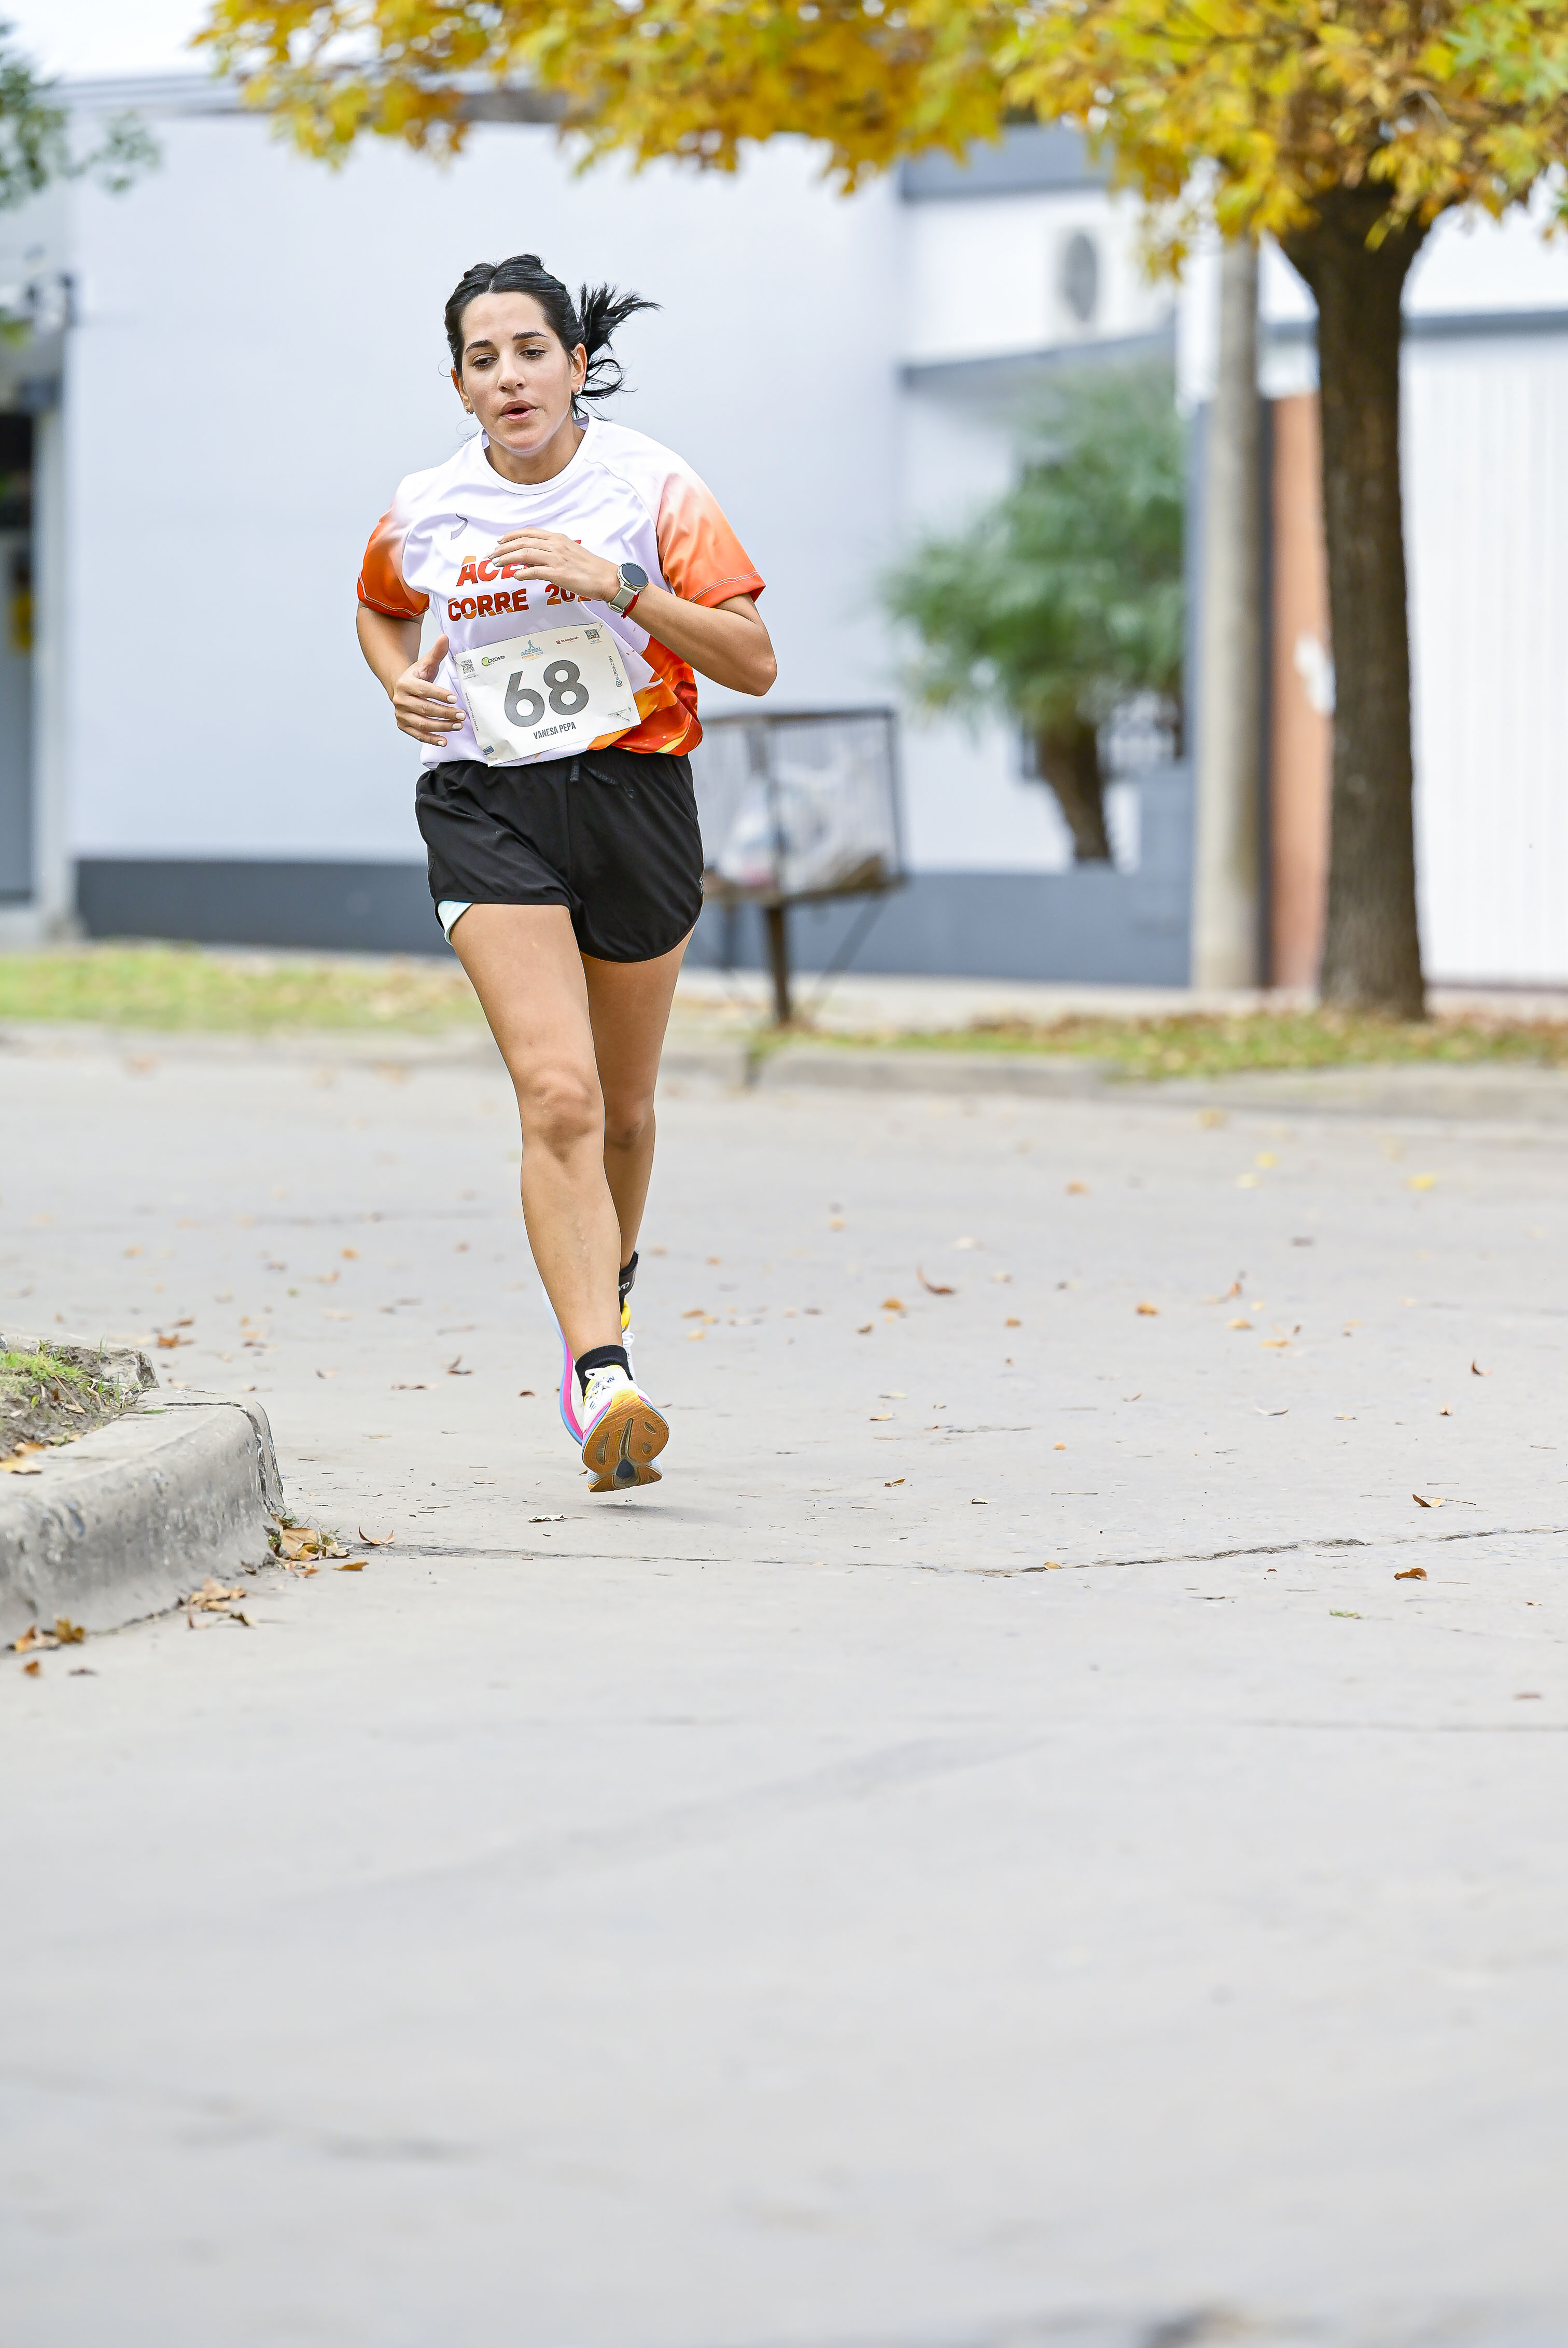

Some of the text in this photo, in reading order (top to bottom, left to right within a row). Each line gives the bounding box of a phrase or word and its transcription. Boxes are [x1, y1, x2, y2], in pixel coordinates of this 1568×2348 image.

[448, 583, 592, 622] CORRE 20
[505, 660, 589, 727] 68
[533, 721, 577, 739] VANESA PEPA
